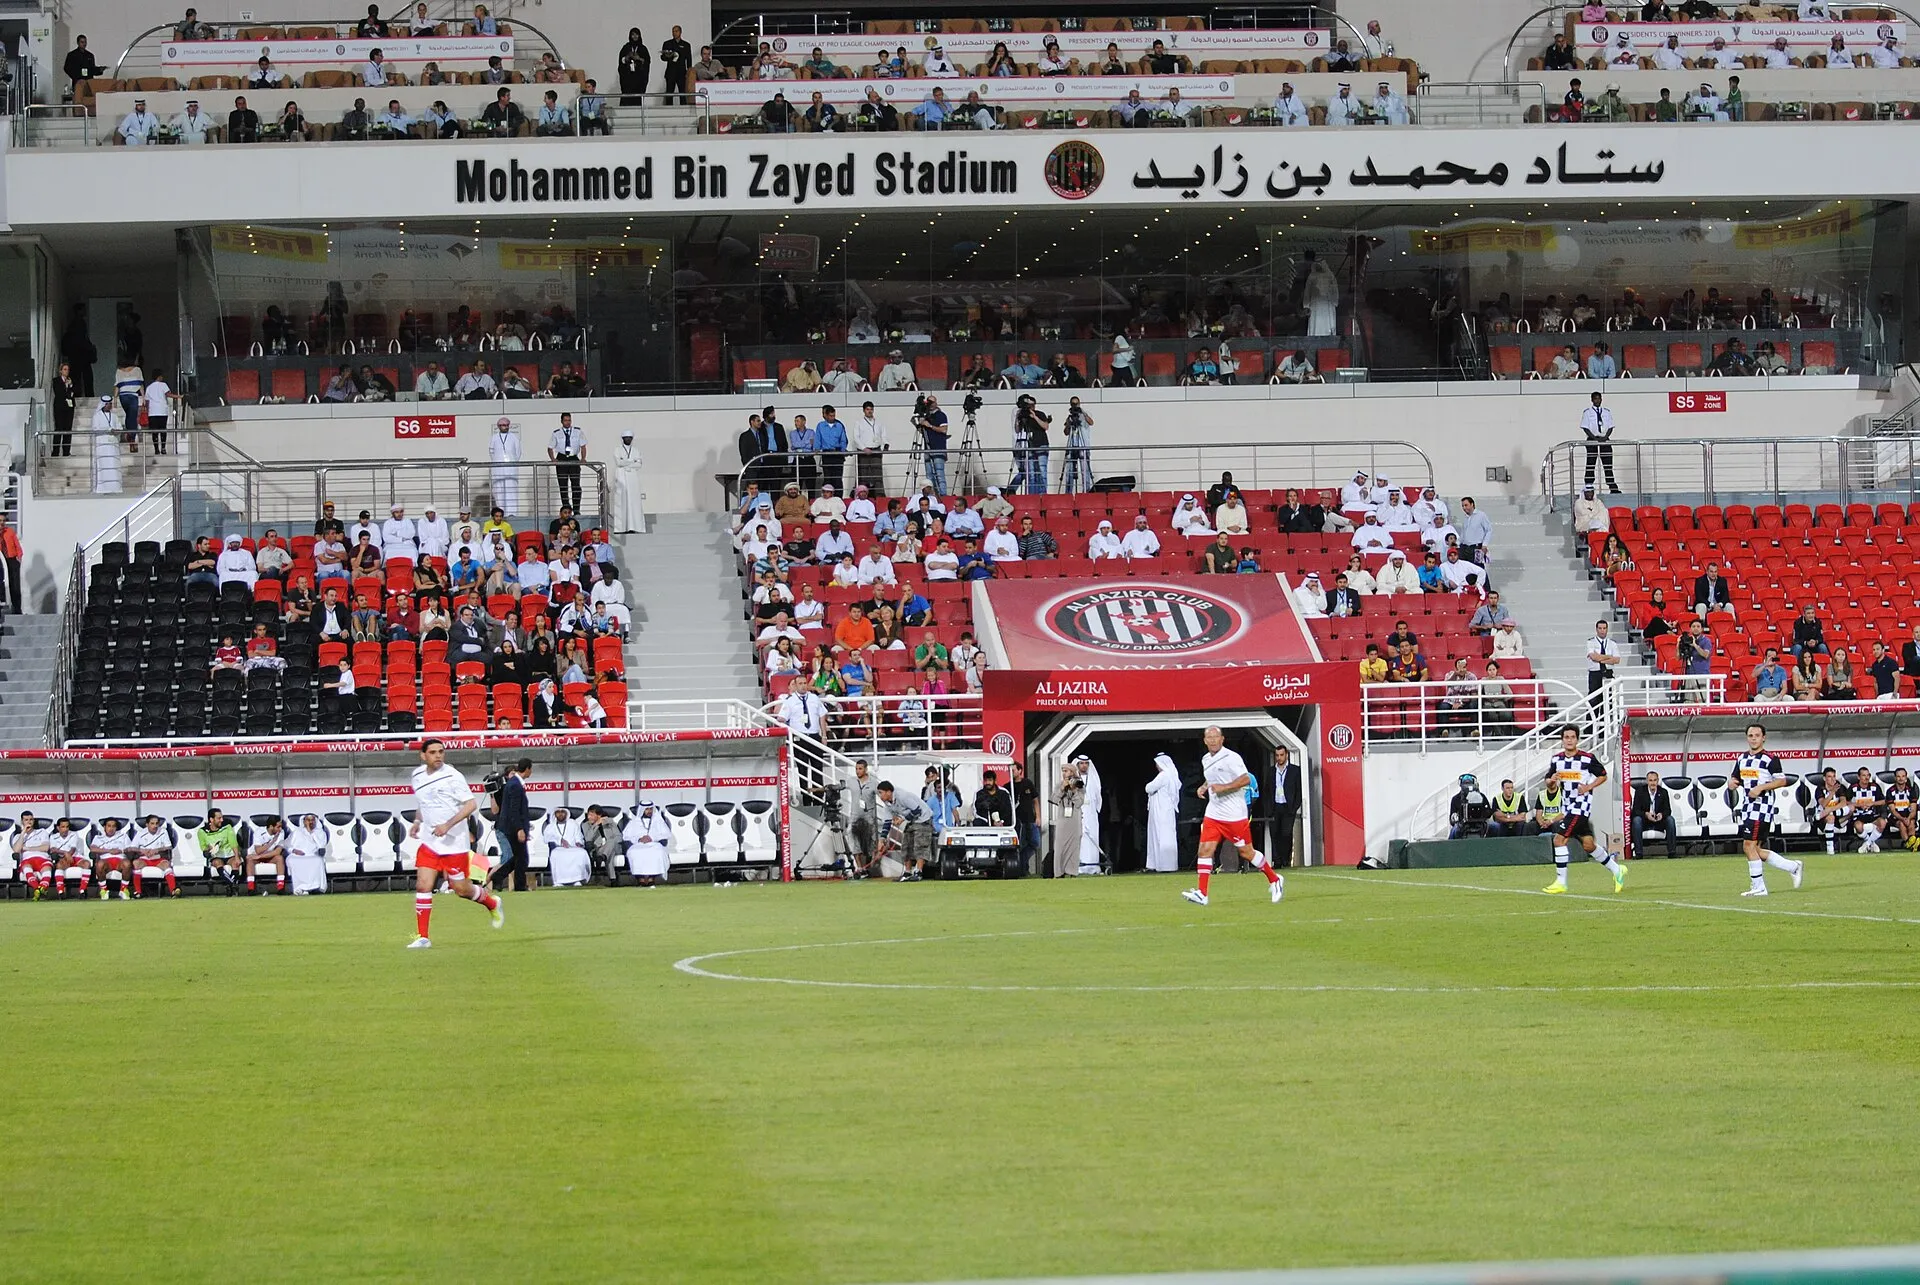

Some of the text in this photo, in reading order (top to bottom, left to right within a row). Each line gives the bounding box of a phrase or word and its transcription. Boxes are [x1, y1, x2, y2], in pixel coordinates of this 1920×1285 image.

[1525, 141, 1666, 185] ستاد
[455, 150, 1018, 206] Mohammed Bin Zayed Stadium
[1131, 143, 1250, 200] زايد
[1350, 154, 1510, 191] محمد
[1265, 160, 1333, 199] بن
[1676, 395, 1695, 408] S5
[398, 420, 420, 434] S6
[1066, 590, 1214, 613] AL JAZIRA CLUB
[1100, 641, 1130, 651] ABU
[1263, 673, 1310, 690] الجزيرة
[1035, 682, 1108, 698] AL JAZIRA
[1646, 707, 1702, 716] WWW.JC.AE
[619, 733, 677, 743] WWW.JC.AE
[712, 728, 770, 739] WWW.JC.AE
[442, 740, 486, 749] WW.JC.AE
[521, 737, 579, 746] WWW.JC.AE
[524, 783, 552, 791] W.JC.AE
[580, 781, 623, 789] WWW.JC.AE
[723, 777, 766, 785] WWW.JC.AE
[780, 761, 788, 805] WWW.JC.AE
[223, 790, 267, 798] WWW.JC.AE
